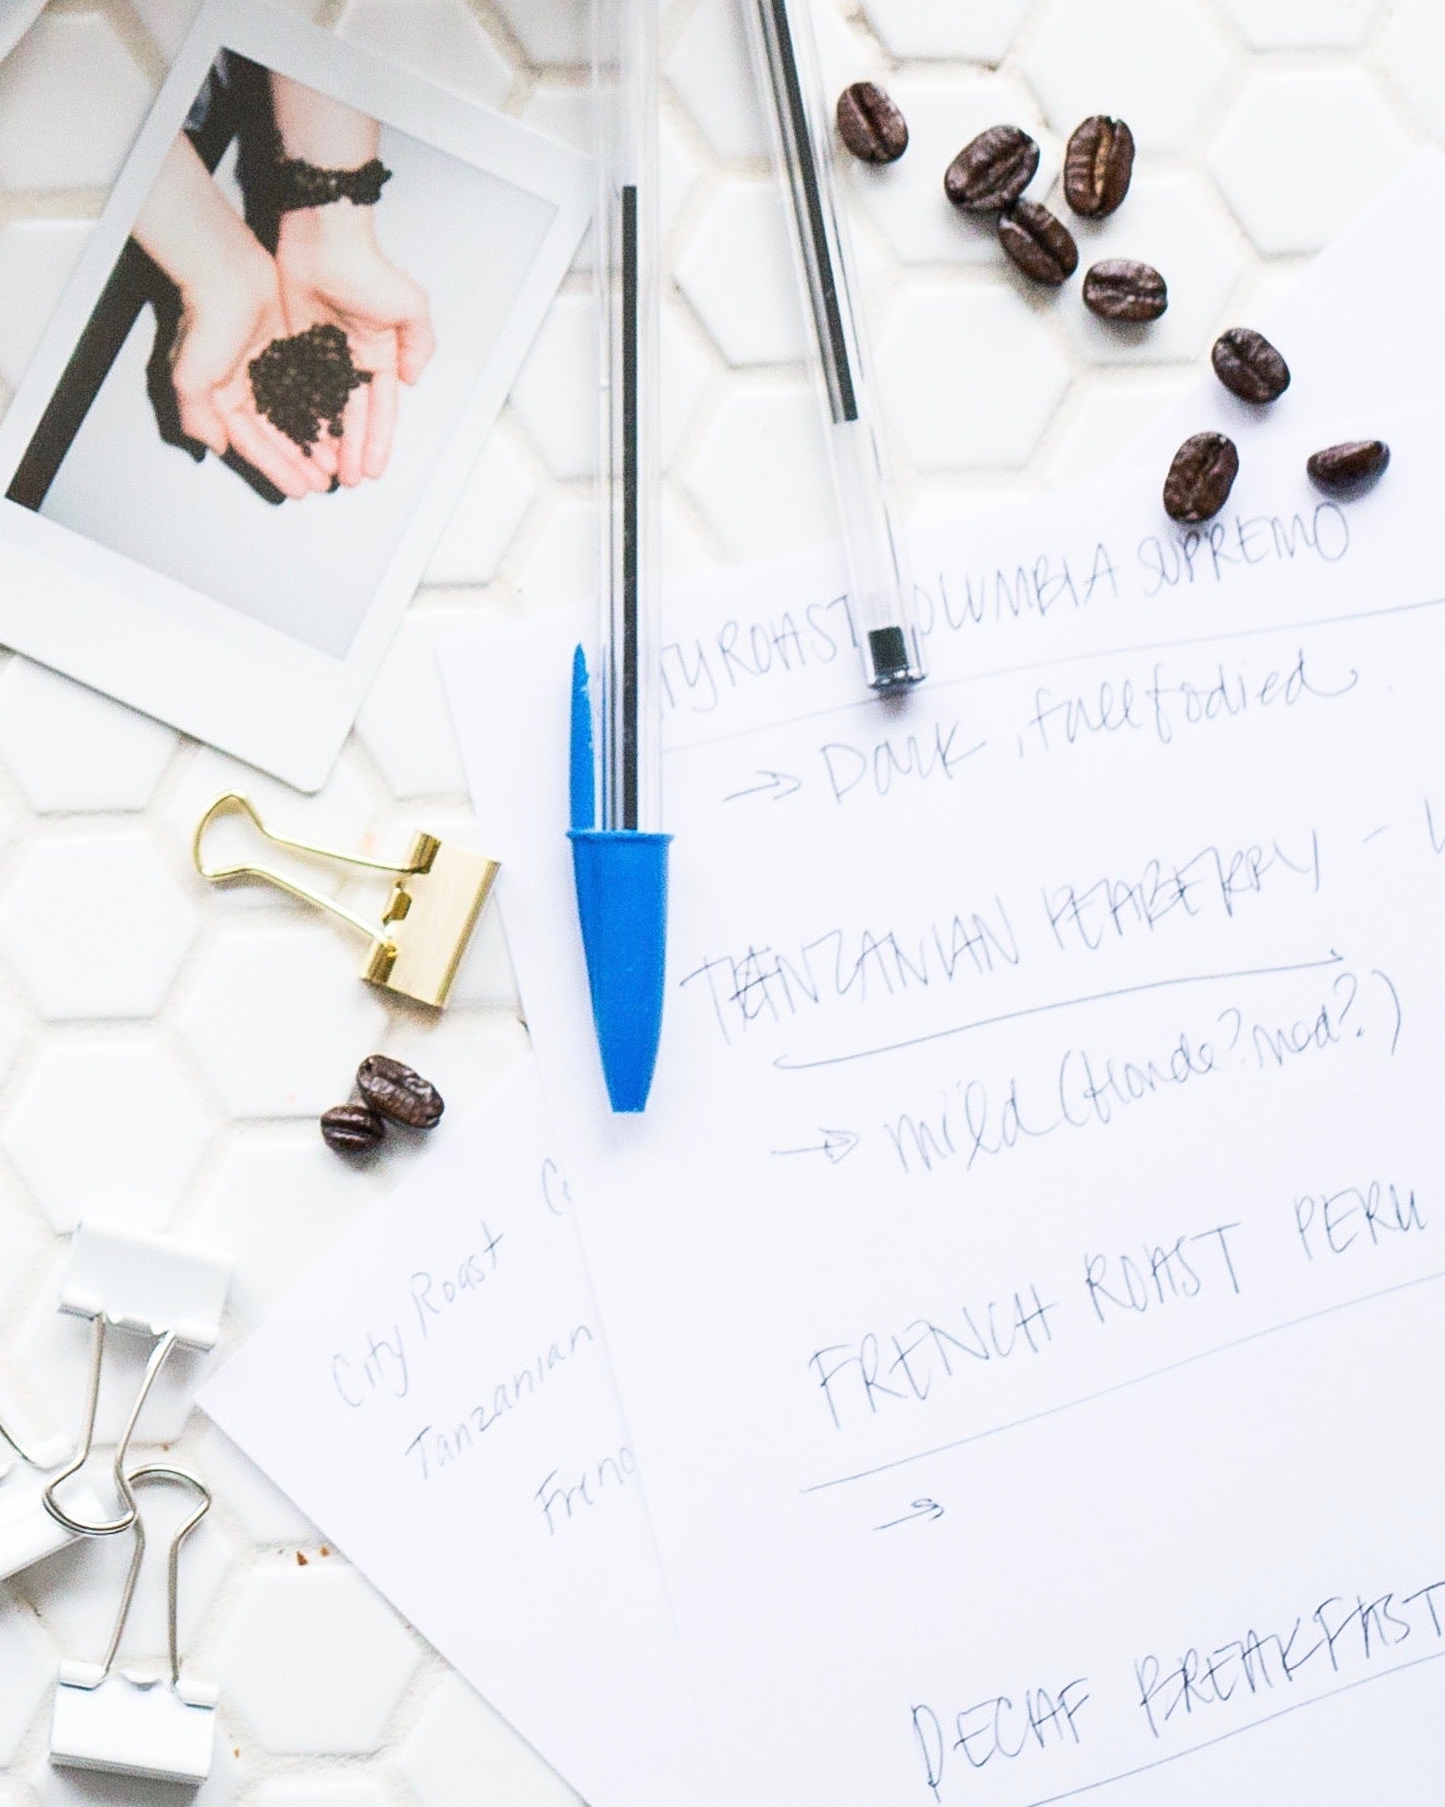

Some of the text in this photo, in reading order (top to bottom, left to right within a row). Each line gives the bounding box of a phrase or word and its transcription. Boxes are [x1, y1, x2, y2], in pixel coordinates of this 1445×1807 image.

[661, 500, 1350, 713] TYROAST OLUMBIA SUPREMO
[331, 1218, 505, 1409] City Roast
[807, 1180, 1429, 1429] FRENCH ROAST PERU
[403, 1322, 595, 1481] Tanzanian
[910, 1676, 1091, 1805] DECAF
